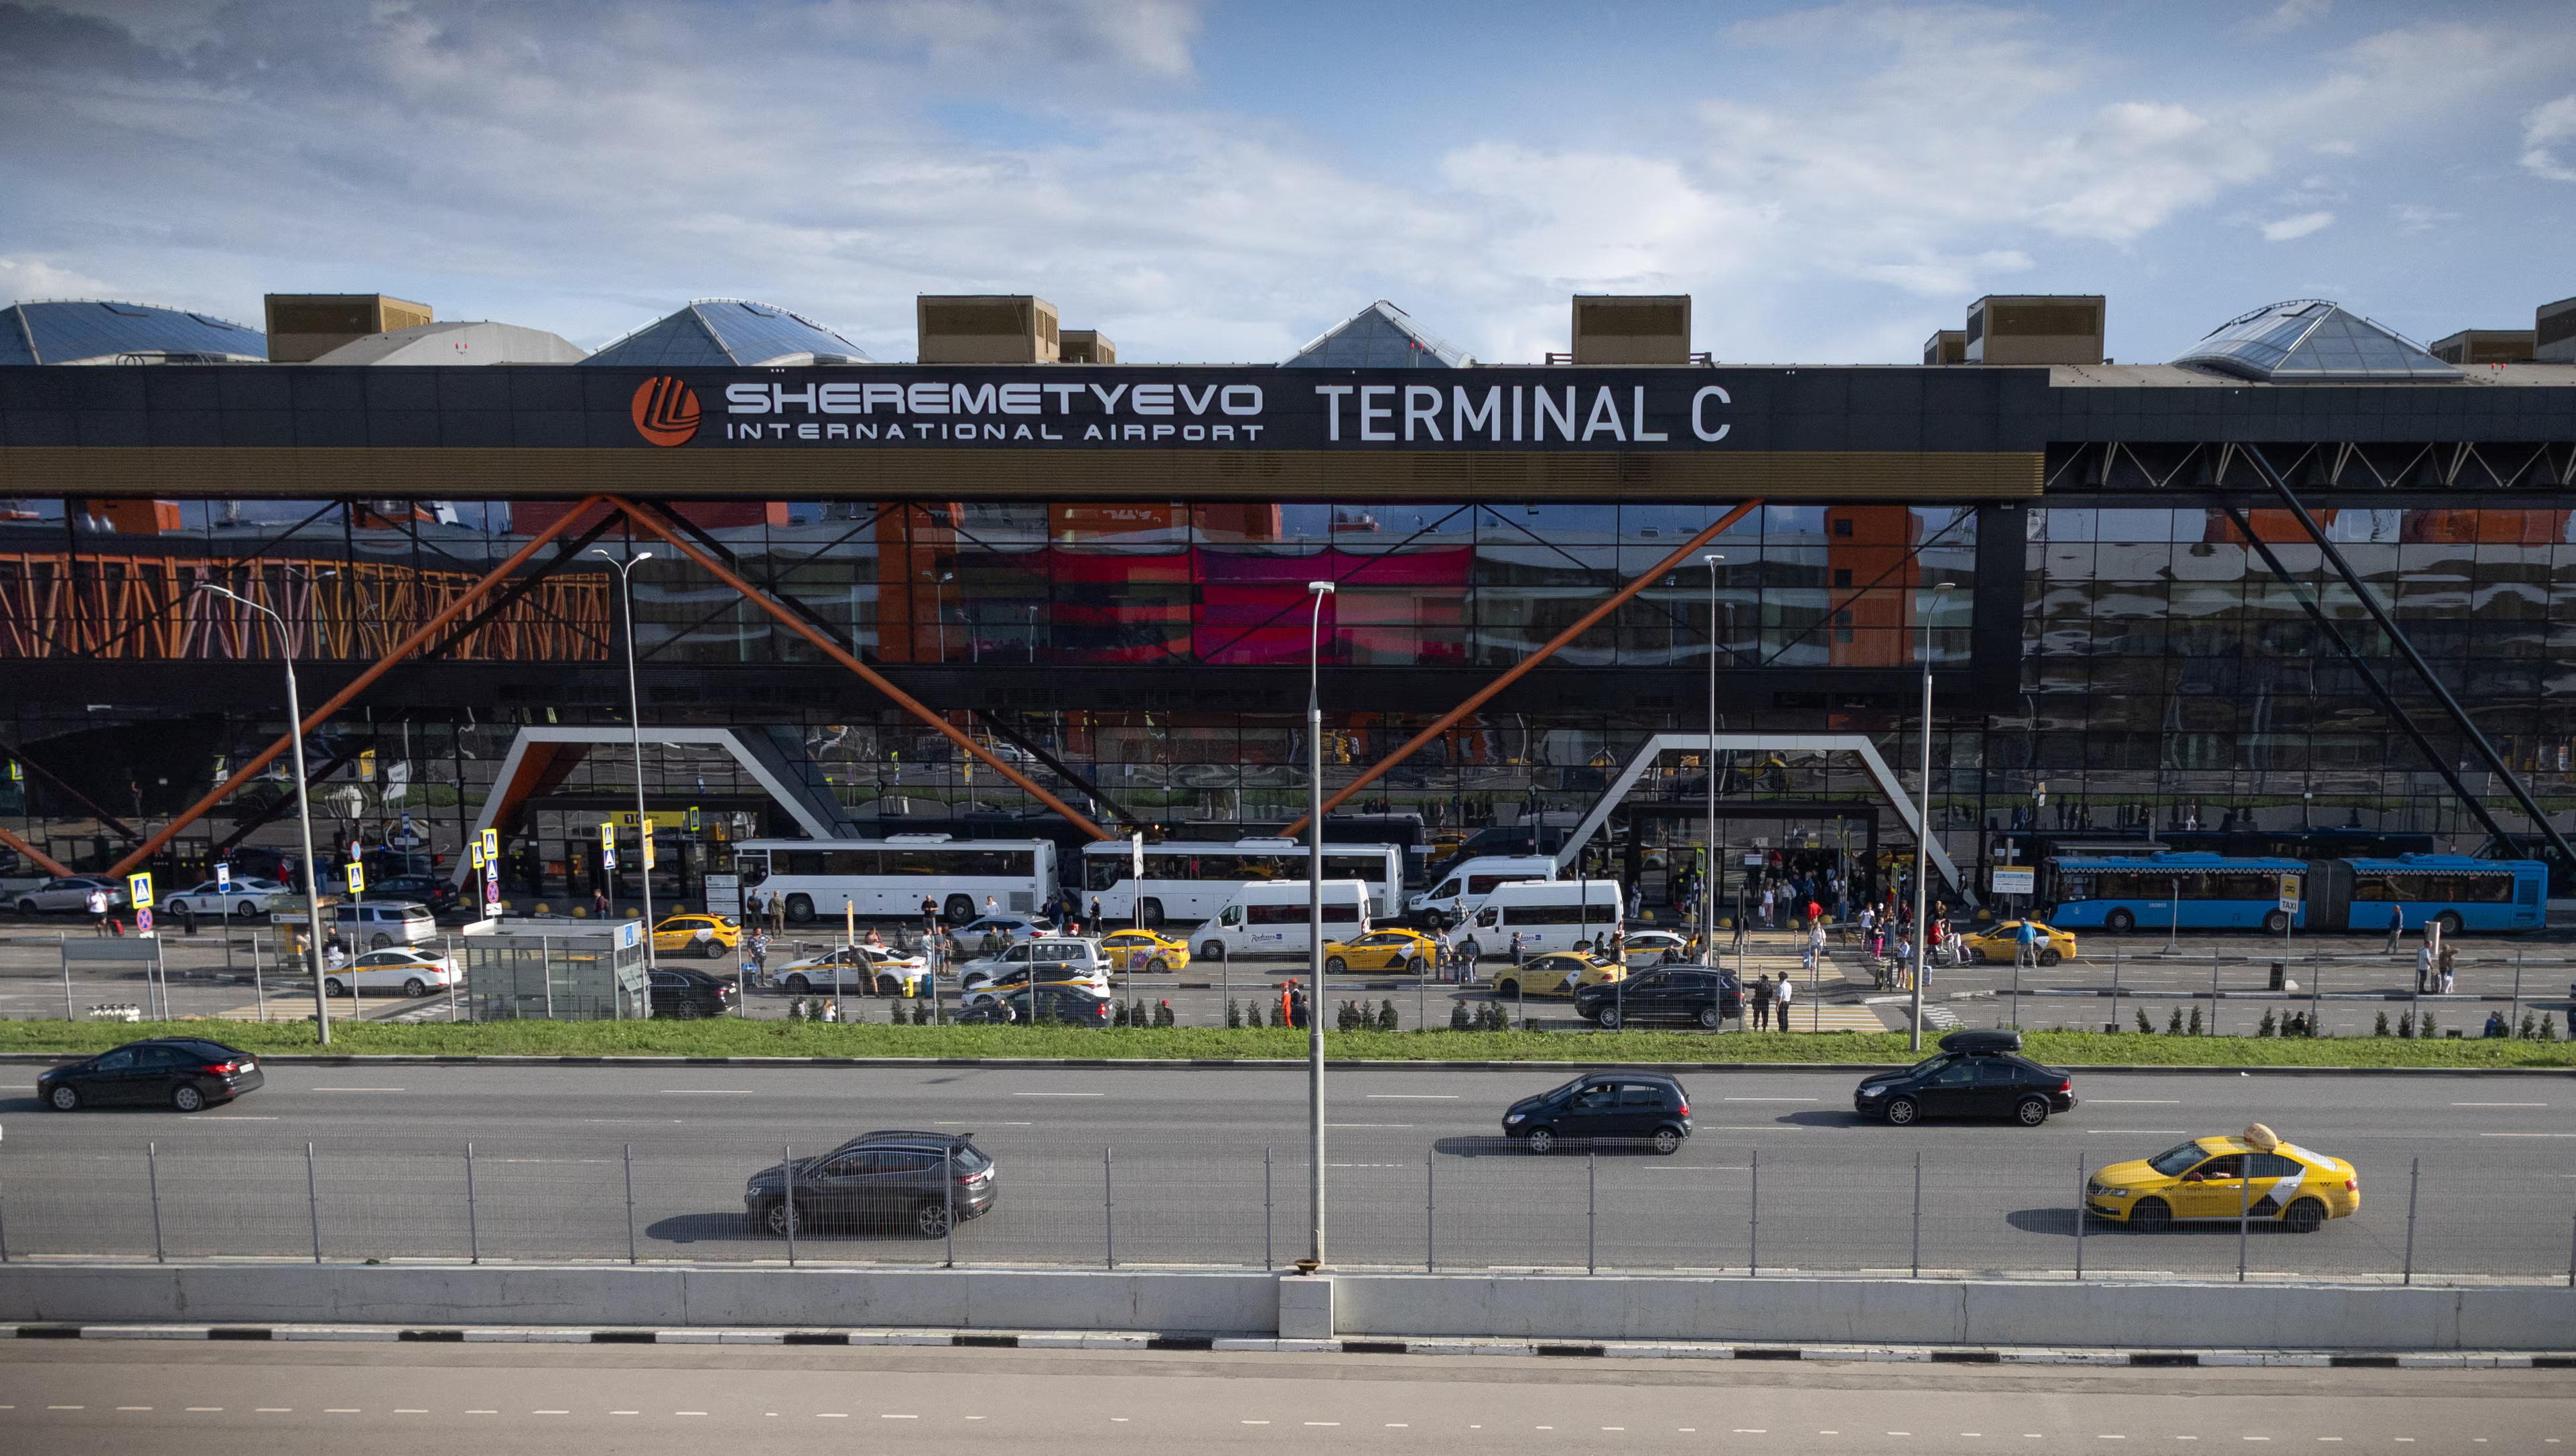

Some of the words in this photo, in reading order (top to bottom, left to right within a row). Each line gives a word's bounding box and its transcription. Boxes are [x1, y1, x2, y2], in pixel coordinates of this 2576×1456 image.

[726, 383, 1263, 415] SHEREMETYEVO
[1316, 385, 1668, 442] TERMINAL
[1692, 385, 1731, 442] C
[727, 423, 1063, 440] INTERNATIONAL
[1083, 424, 1264, 441] AIRPORT
[2282, 901, 2297, 910] TAXI
